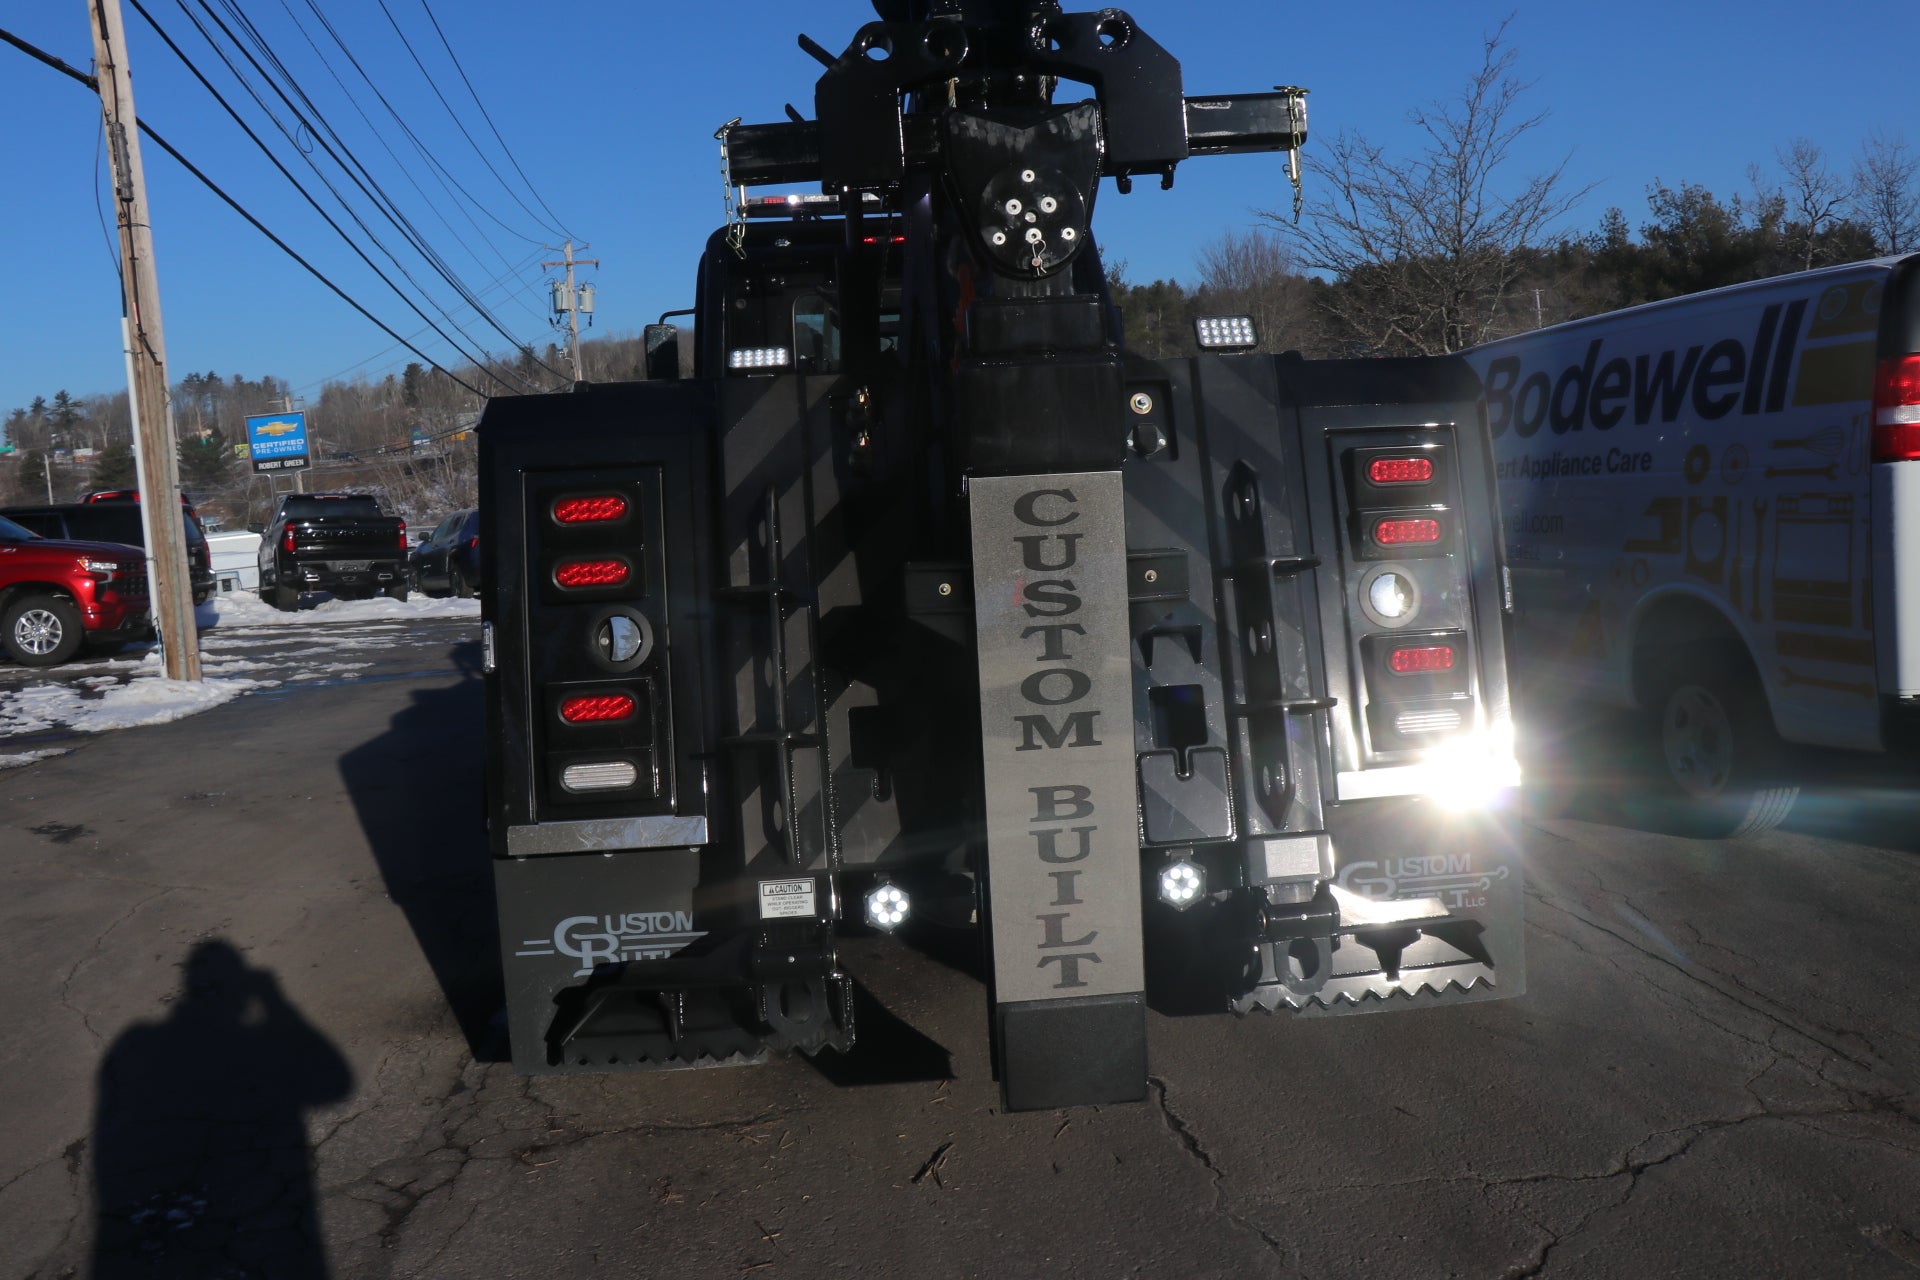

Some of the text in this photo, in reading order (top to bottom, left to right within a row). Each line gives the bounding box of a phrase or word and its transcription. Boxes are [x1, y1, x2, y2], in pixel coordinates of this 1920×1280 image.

[1484, 298, 1808, 440] Bodewell
[253, 439, 304, 449] CERTIFIED
[256, 445, 303, 454] PRE-OWNED
[258, 459, 304, 470] ROBERT GREEN
[1519, 450, 1602, 482] Appliance
[1606, 447, 1653, 474] Care
[1013, 488, 1102, 989] CUSTOM BUILT
[775, 884, 802, 893] CAUTION
